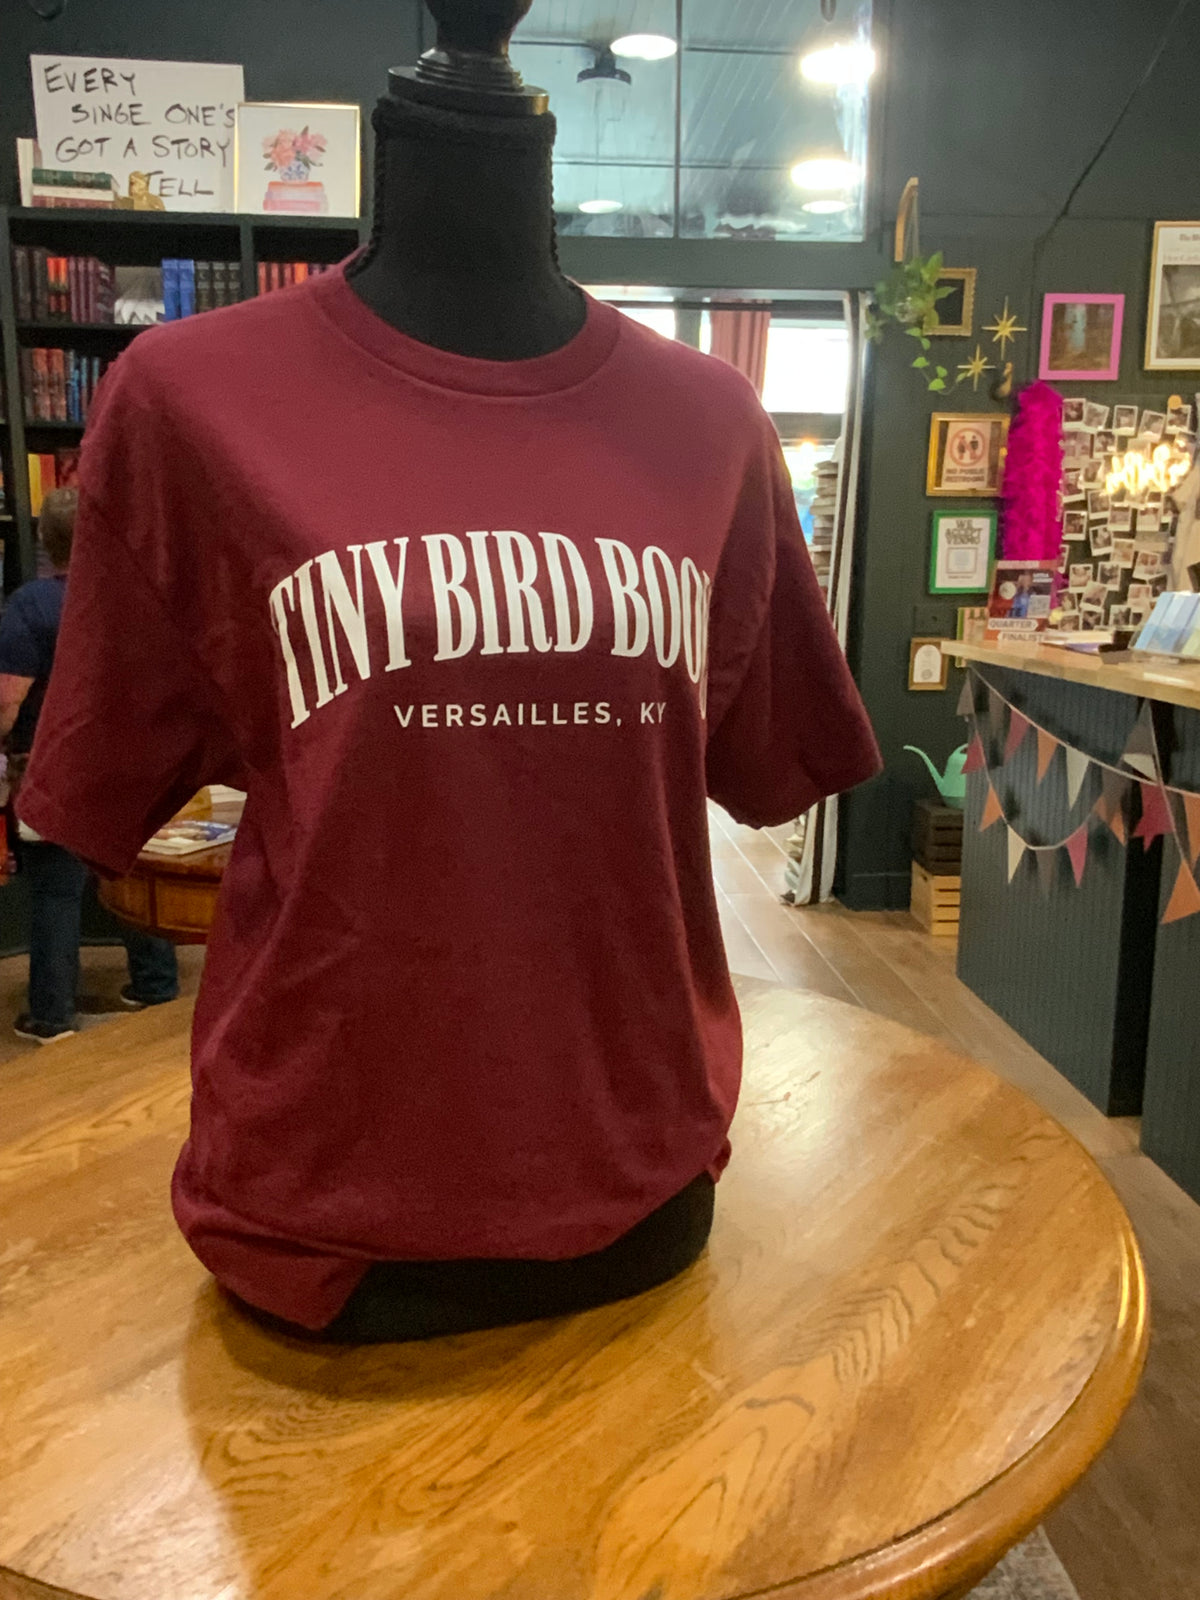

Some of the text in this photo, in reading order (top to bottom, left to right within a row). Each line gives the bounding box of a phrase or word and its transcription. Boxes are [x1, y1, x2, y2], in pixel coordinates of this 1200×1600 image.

[44, 63, 136, 96] EVERY
[71, 102, 235, 129] SINGE ONE'S
[55, 135, 232, 168] GOT A STORY
[956, 519, 974, 529] WE
[269, 536, 412, 729] TINY
[421, 530, 594, 662] BIRD
[393, 702, 667, 728] VERSAILLES, KY
